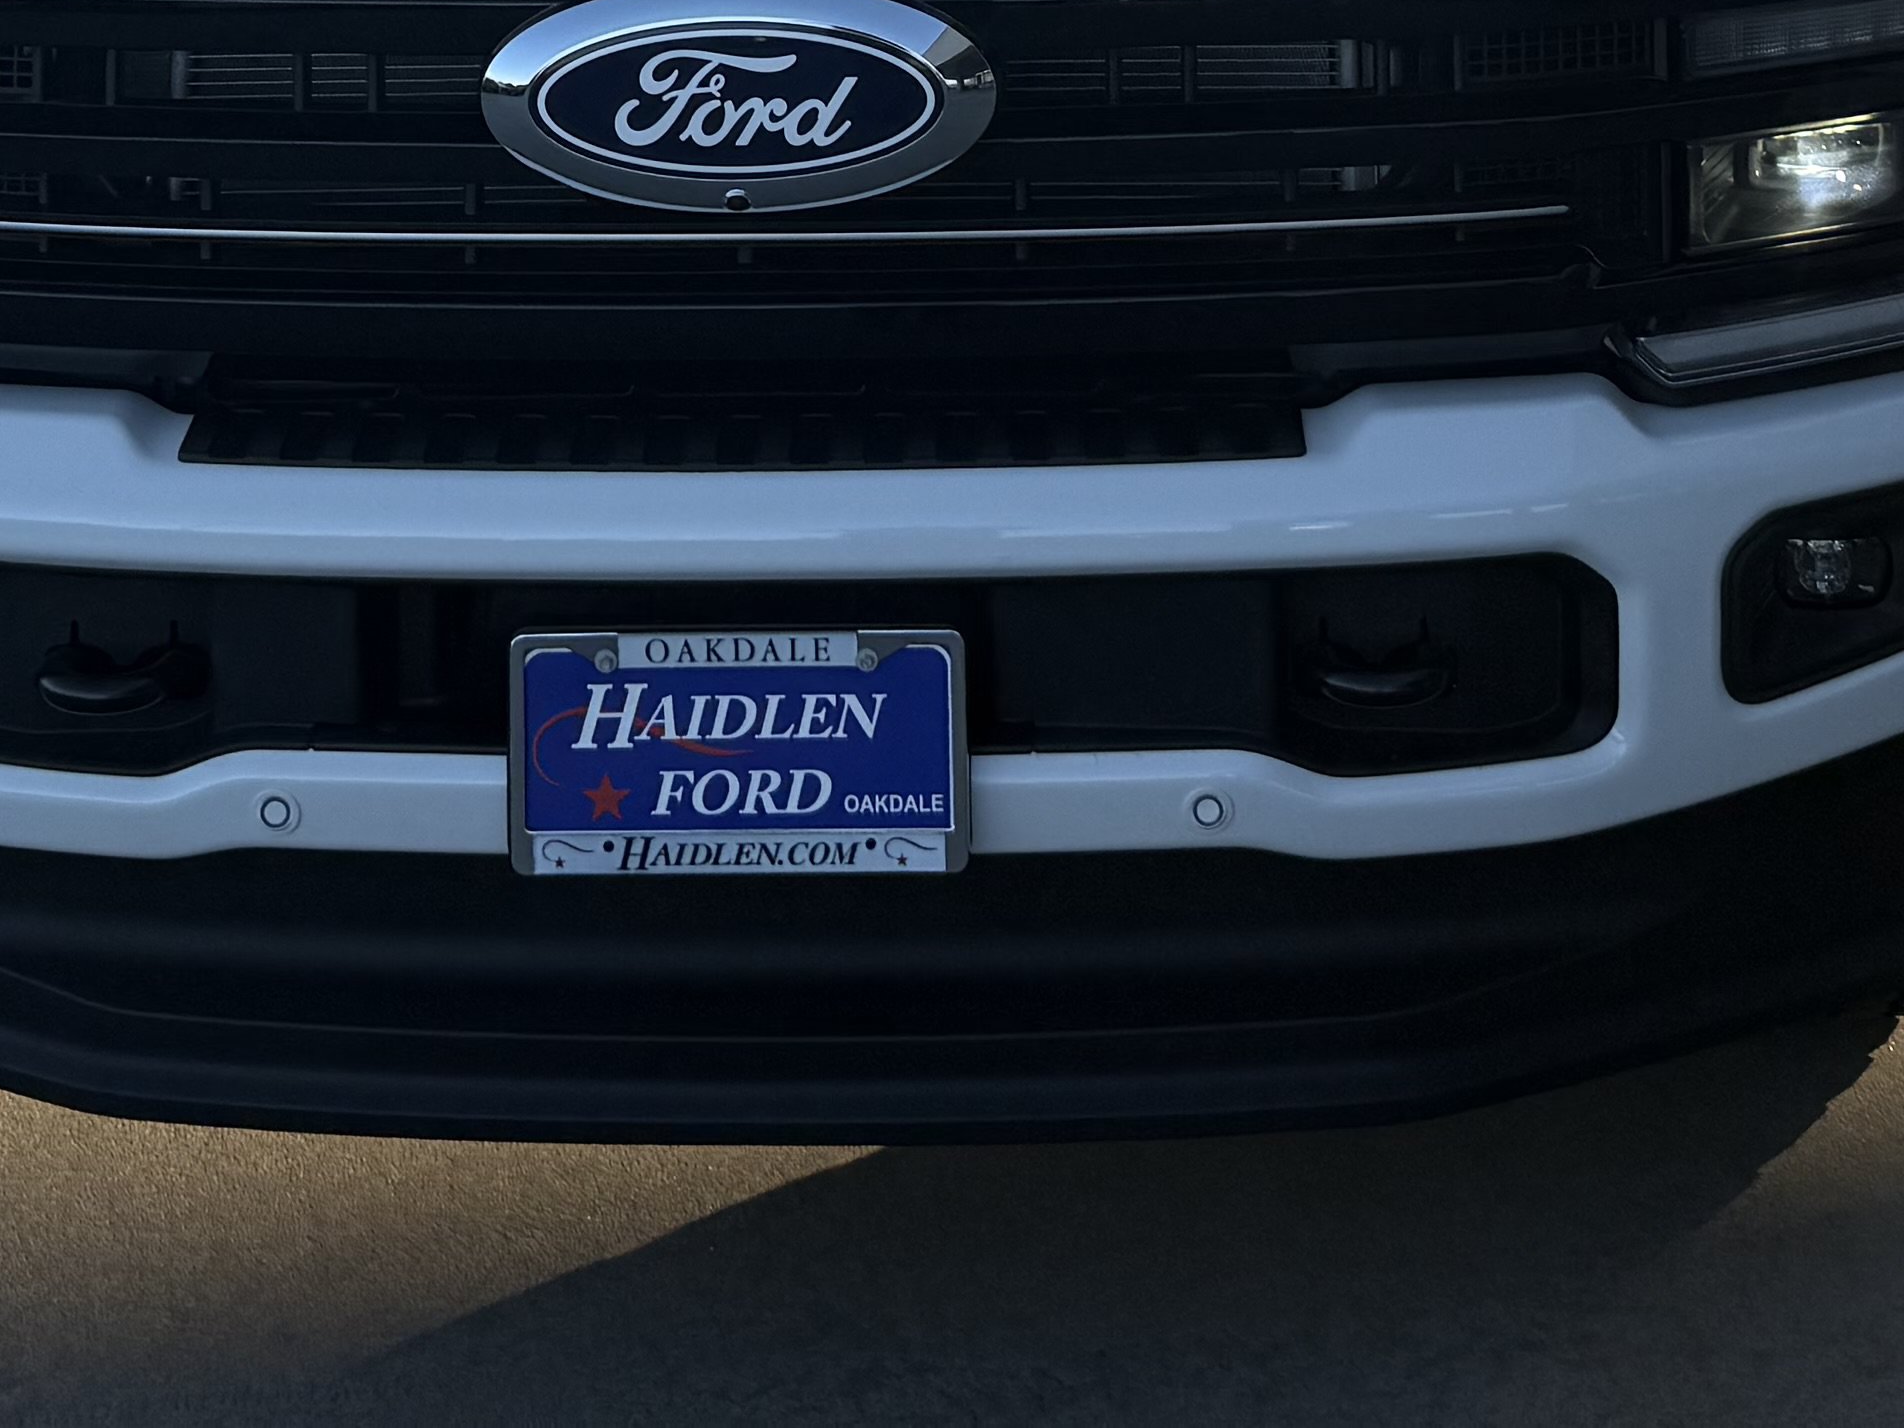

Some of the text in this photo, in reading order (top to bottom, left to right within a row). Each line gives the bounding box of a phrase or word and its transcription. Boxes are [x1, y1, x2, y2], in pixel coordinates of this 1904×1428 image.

[614, 49, 859, 147] Ford
[645, 636, 831, 664] OAKDALE
[571, 682, 887, 750] HAIDLEN
[651, 769, 945, 816] FORD OAKDALE
[616, 835, 860, 871] HAIDLEN.COM
